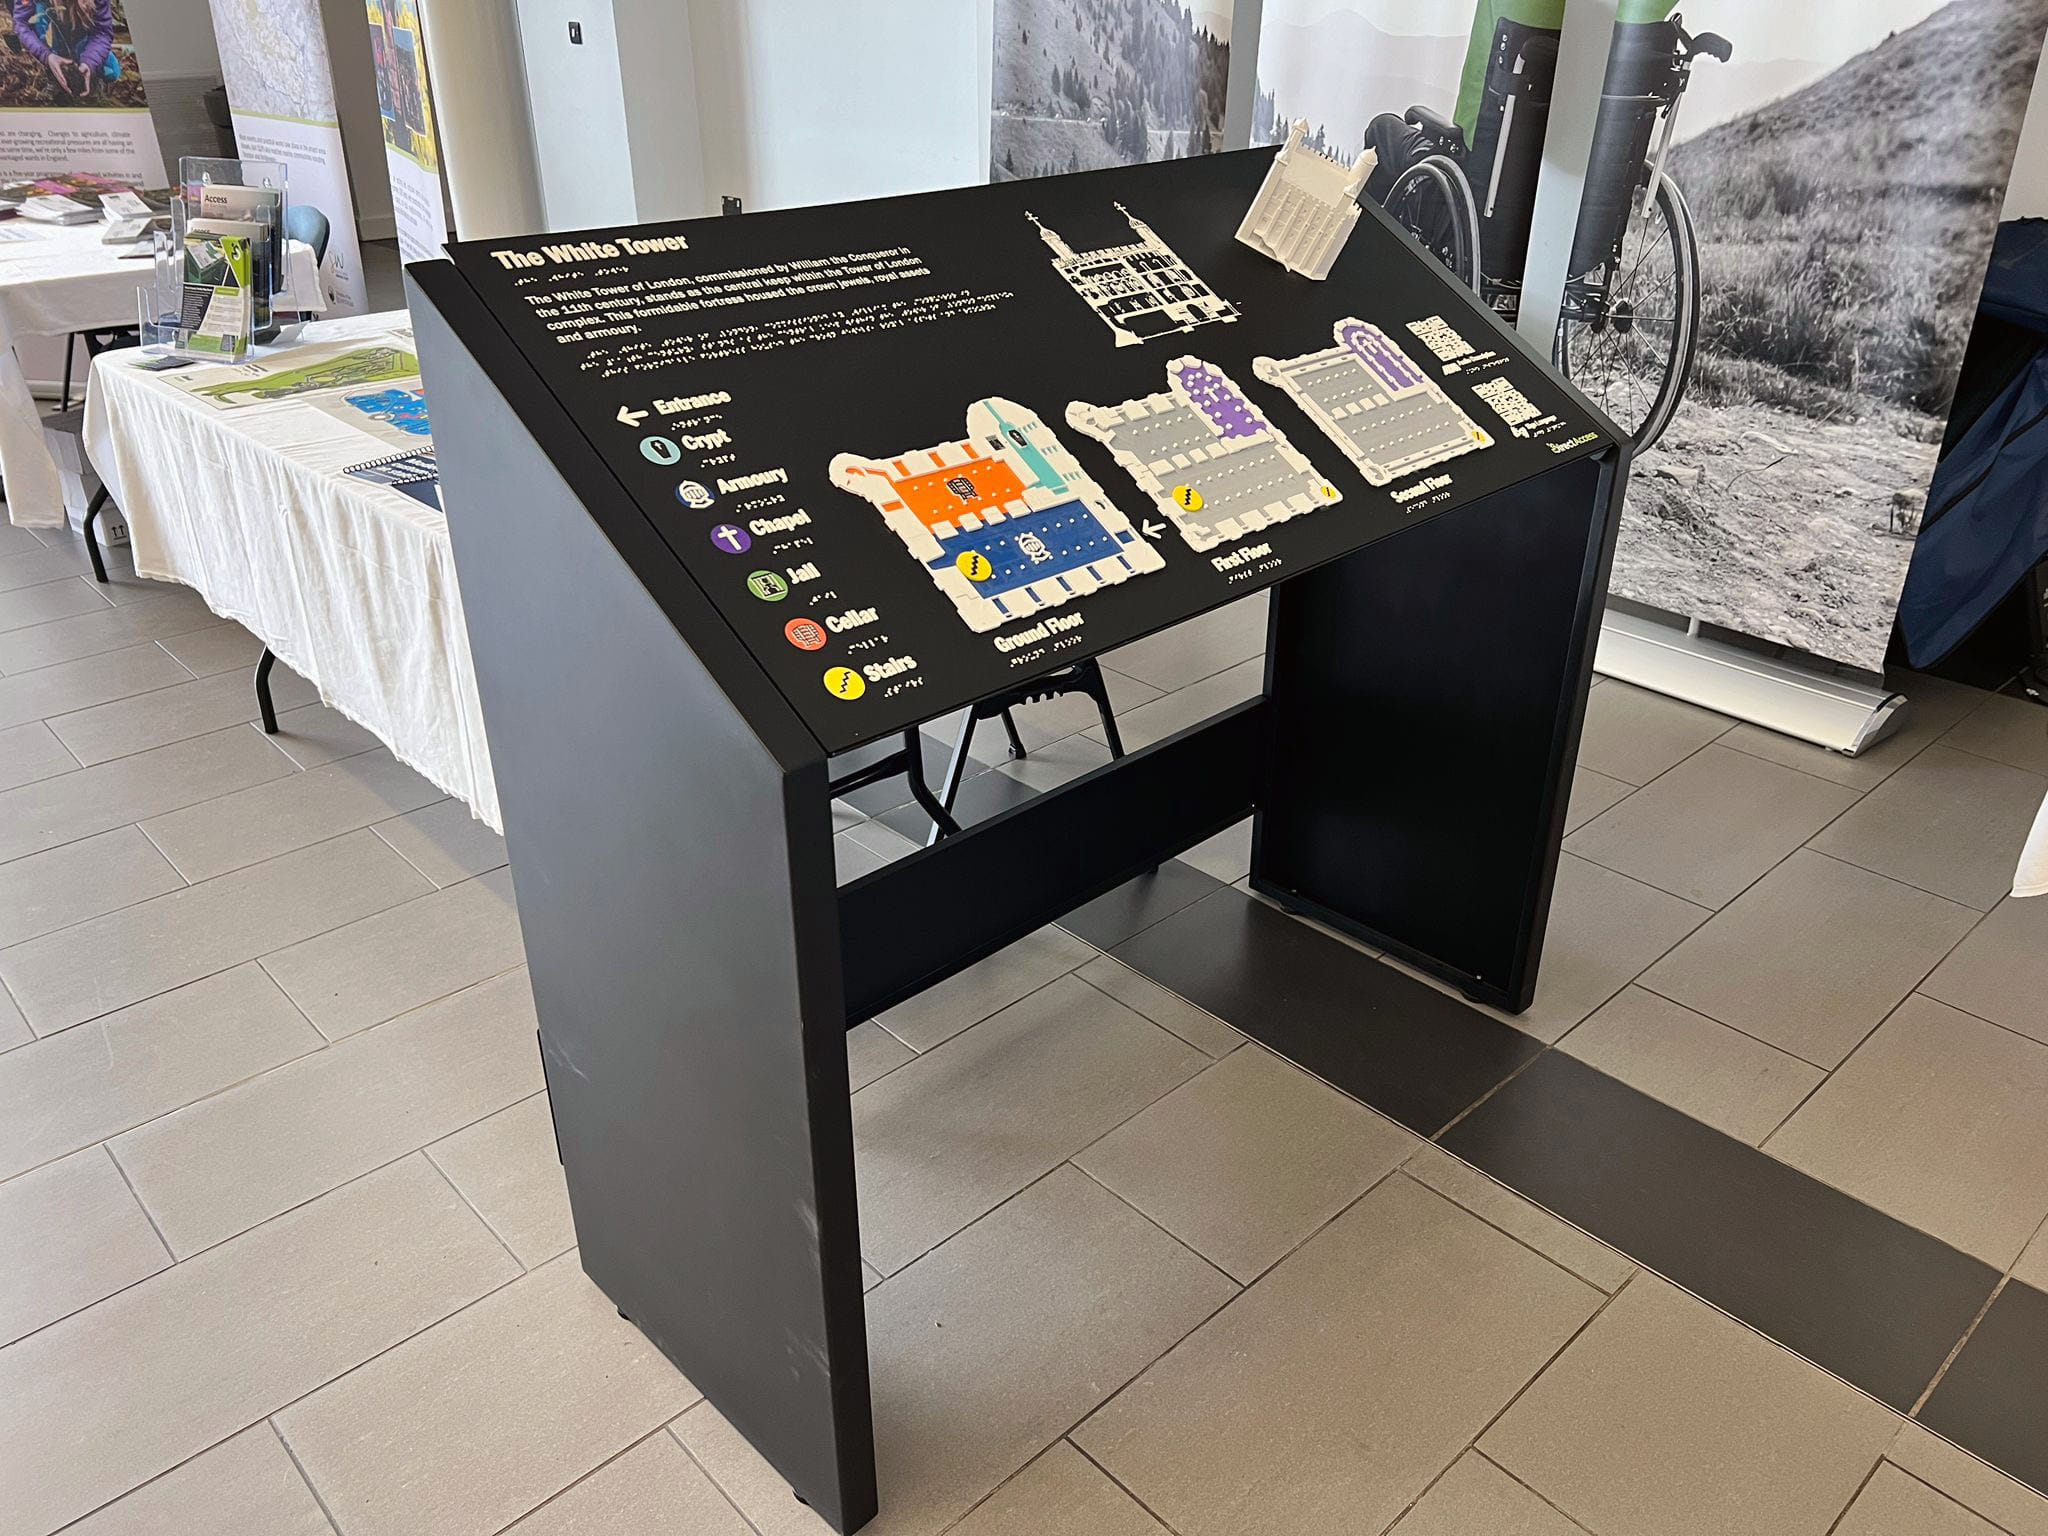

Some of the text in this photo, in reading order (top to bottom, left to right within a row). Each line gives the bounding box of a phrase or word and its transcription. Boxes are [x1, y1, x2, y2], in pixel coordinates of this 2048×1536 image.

[205, 194, 228, 204] Access
[491, 234, 689, 270] The White Tower
[524, 245, 911, 306] The White Tower of London, commissioned by William the Conqueror in
[536, 255, 923, 318] the 11th century, stands as the central keep within the Tower of London
[546, 266, 931, 331] complex. This formidable fortress housed the crown jewels, royal assets
[556, 323, 642, 344] and armoury.
[652, 390, 733, 415] Entrance
[681, 428, 733, 451] Crypt
[716, 466, 789, 496] Armoury
[1423, 473, 1453, 490] Floor
[749, 508, 812, 537] Chapel
[1210, 542, 1273, 573] First Floor
[786, 561, 822, 585] Jail
[825, 606, 880, 634] Cellar
[993, 611, 1085, 653] Ground Floor
[863, 655, 918, 683] Stairs
